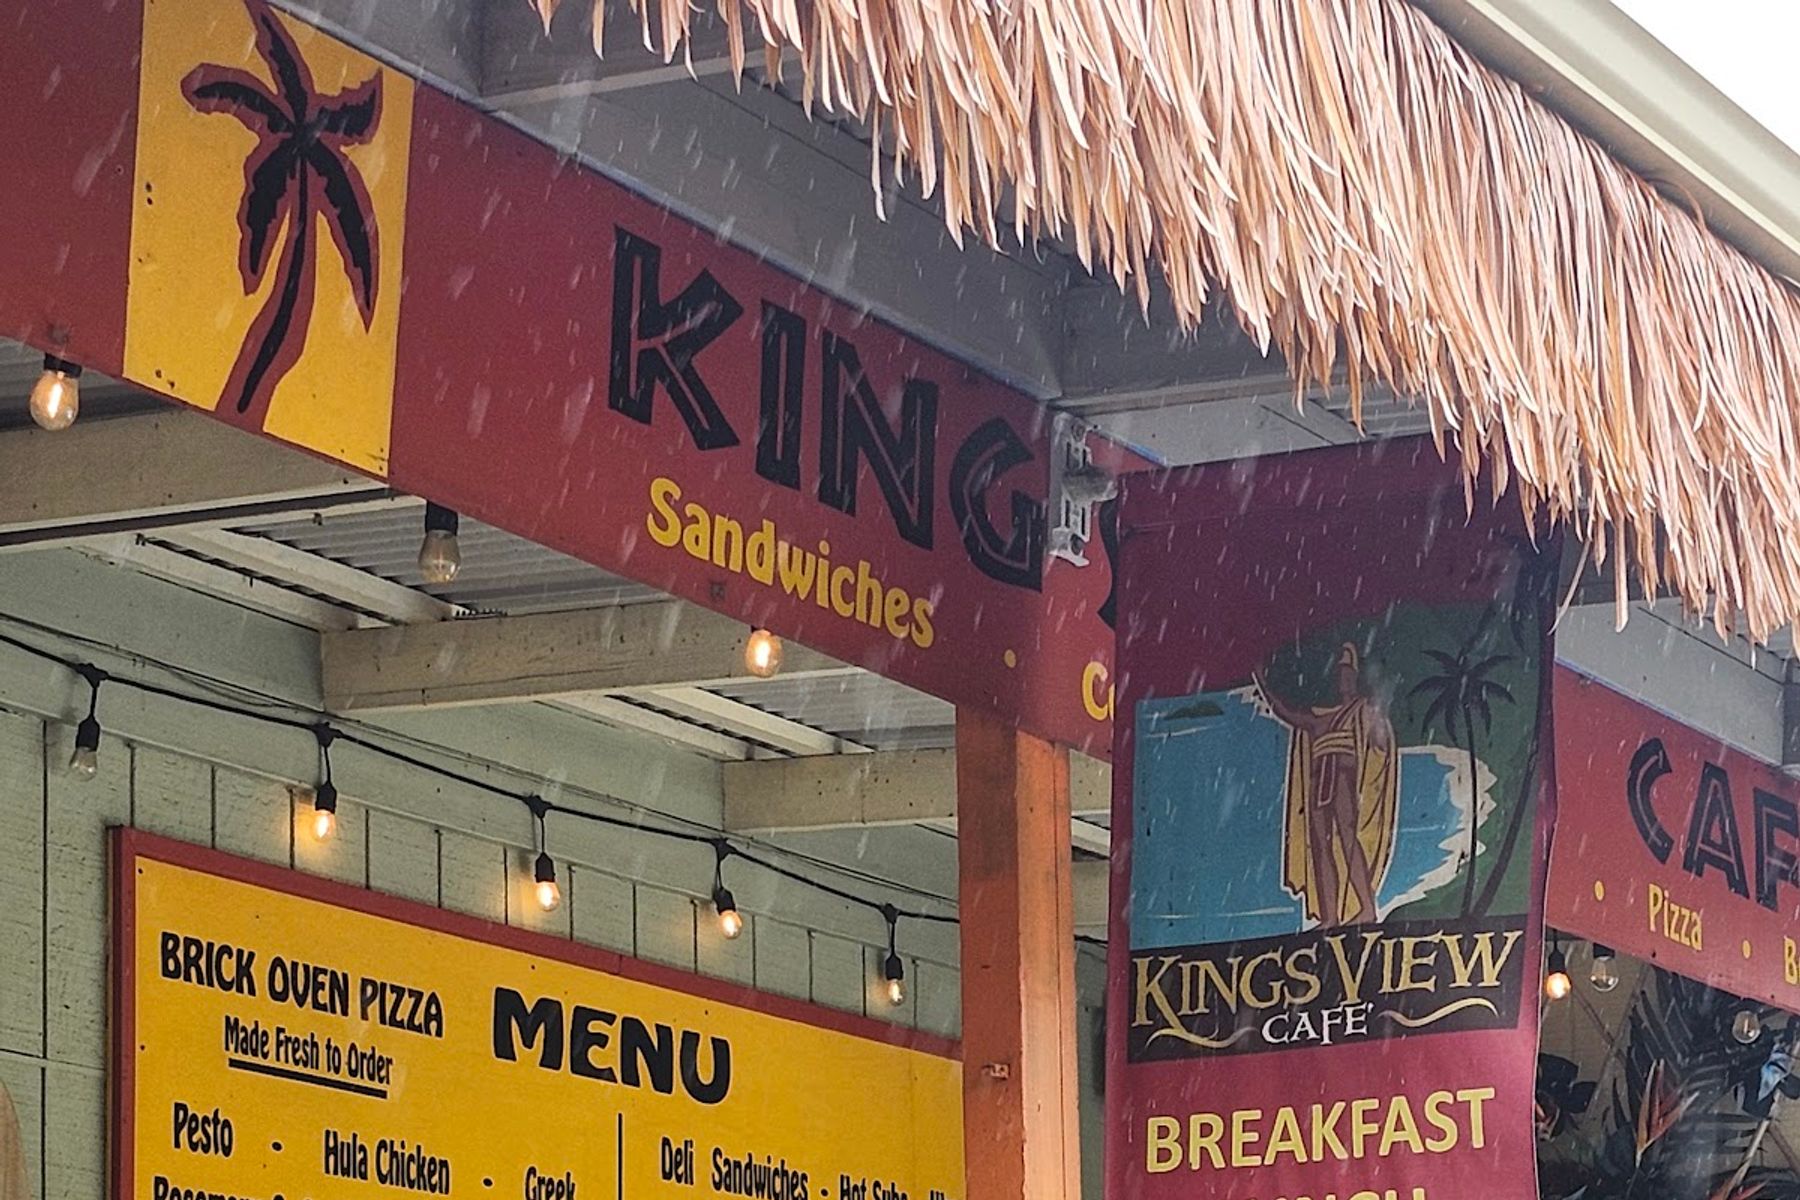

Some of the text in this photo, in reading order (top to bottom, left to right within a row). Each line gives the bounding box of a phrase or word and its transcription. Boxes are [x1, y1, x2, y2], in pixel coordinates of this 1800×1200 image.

[608, 224, 1116, 633] KING
[646, 477, 935, 649] Sandwiches
[1649, 883, 1703, 951] Pizza
[160, 931, 443, 1038] BRICK OVEN PIZZA
[1131, 930, 1524, 1040] KINGS VIEW
[224, 1015, 393, 1085] Made Fresh to Order
[493, 986, 731, 1105] MENU
[173, 1102, 233, 1158] Pesto
[324, 1129, 369, 1181] Hula
[375, 1139, 450, 1195] Chicken
[661, 1136, 694, 1186] Deli
[1146, 1087, 1496, 1174] BREAKFAST
